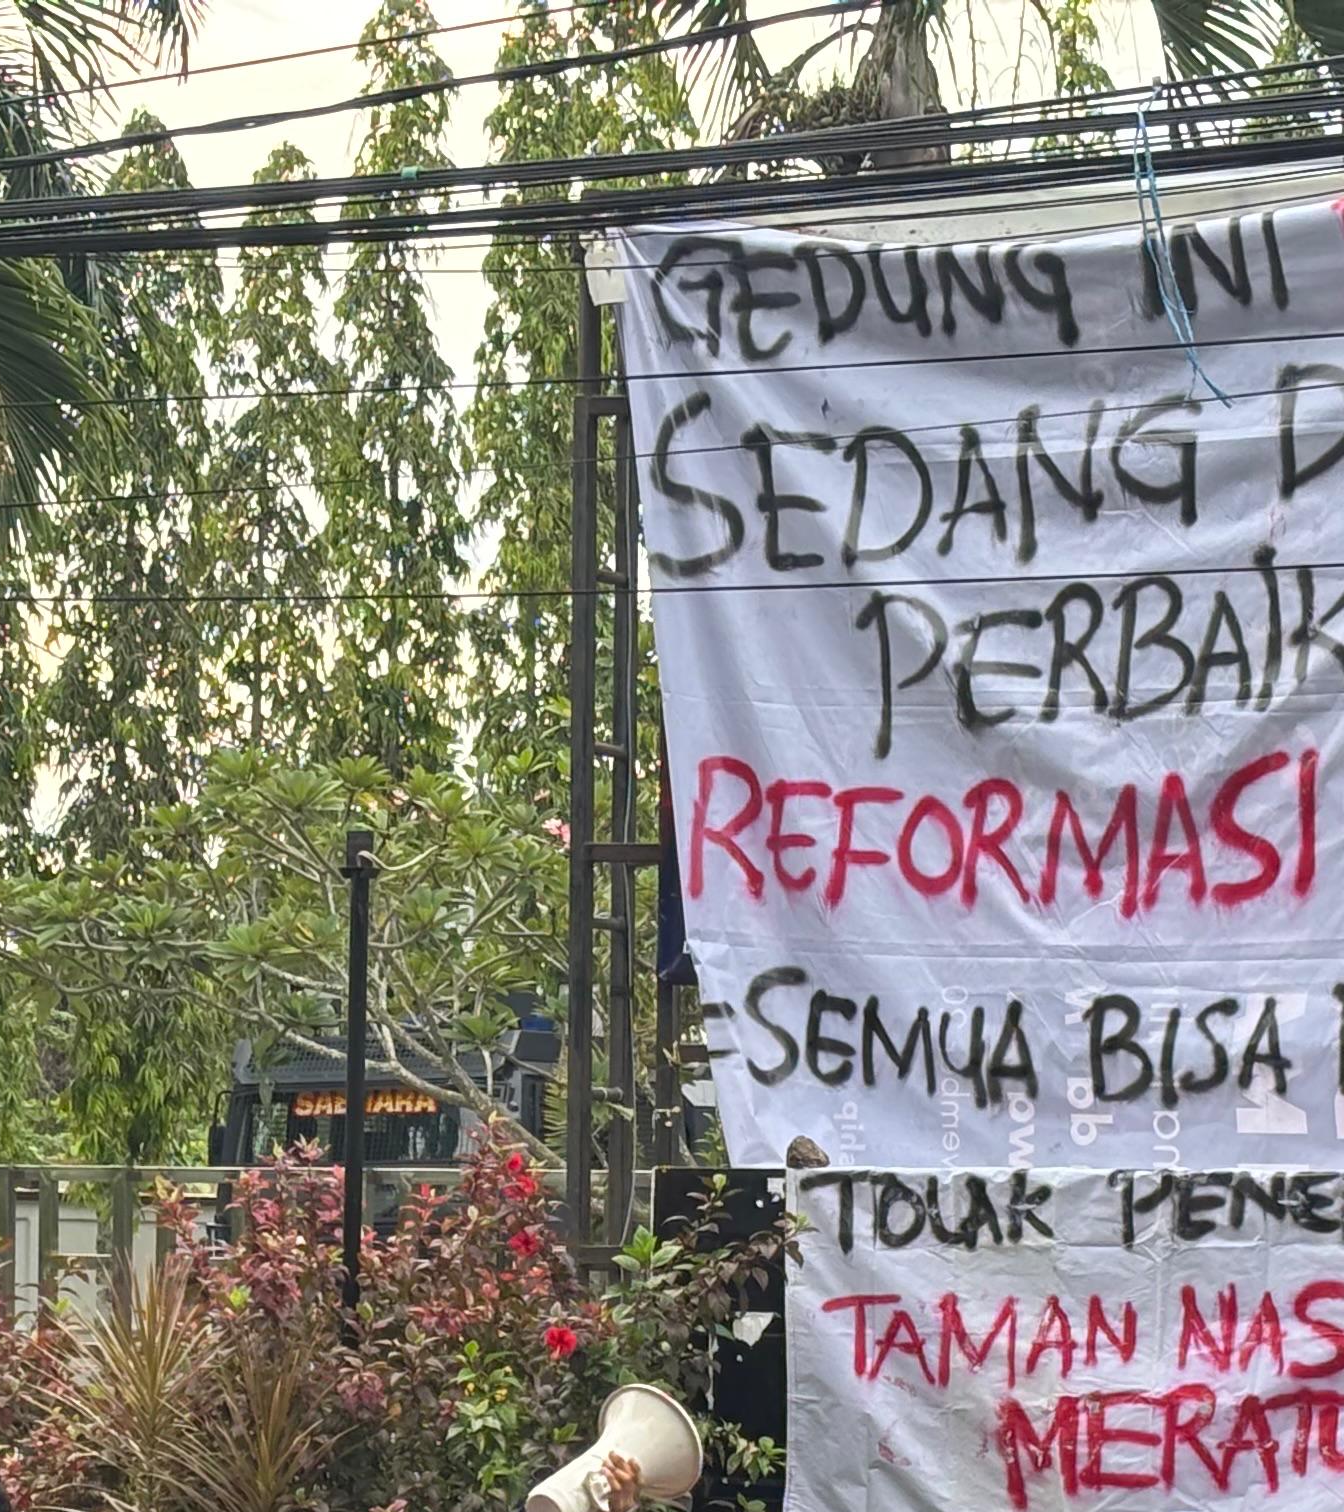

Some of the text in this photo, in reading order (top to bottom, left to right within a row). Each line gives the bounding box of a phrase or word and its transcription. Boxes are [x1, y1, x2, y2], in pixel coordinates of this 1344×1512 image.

[657, 236, 1079, 361] GEDUNG
[1142, 211, 1287, 316] INI
[654, 395, 1201, 574] SEDANG
[689, 748, 1317, 918] REFORMASI
[1083, 993, 1293, 1110] BISA
[800, 1170, 1056, 1252] TOLAK
[824, 1291, 1136, 1389] TAMAN
